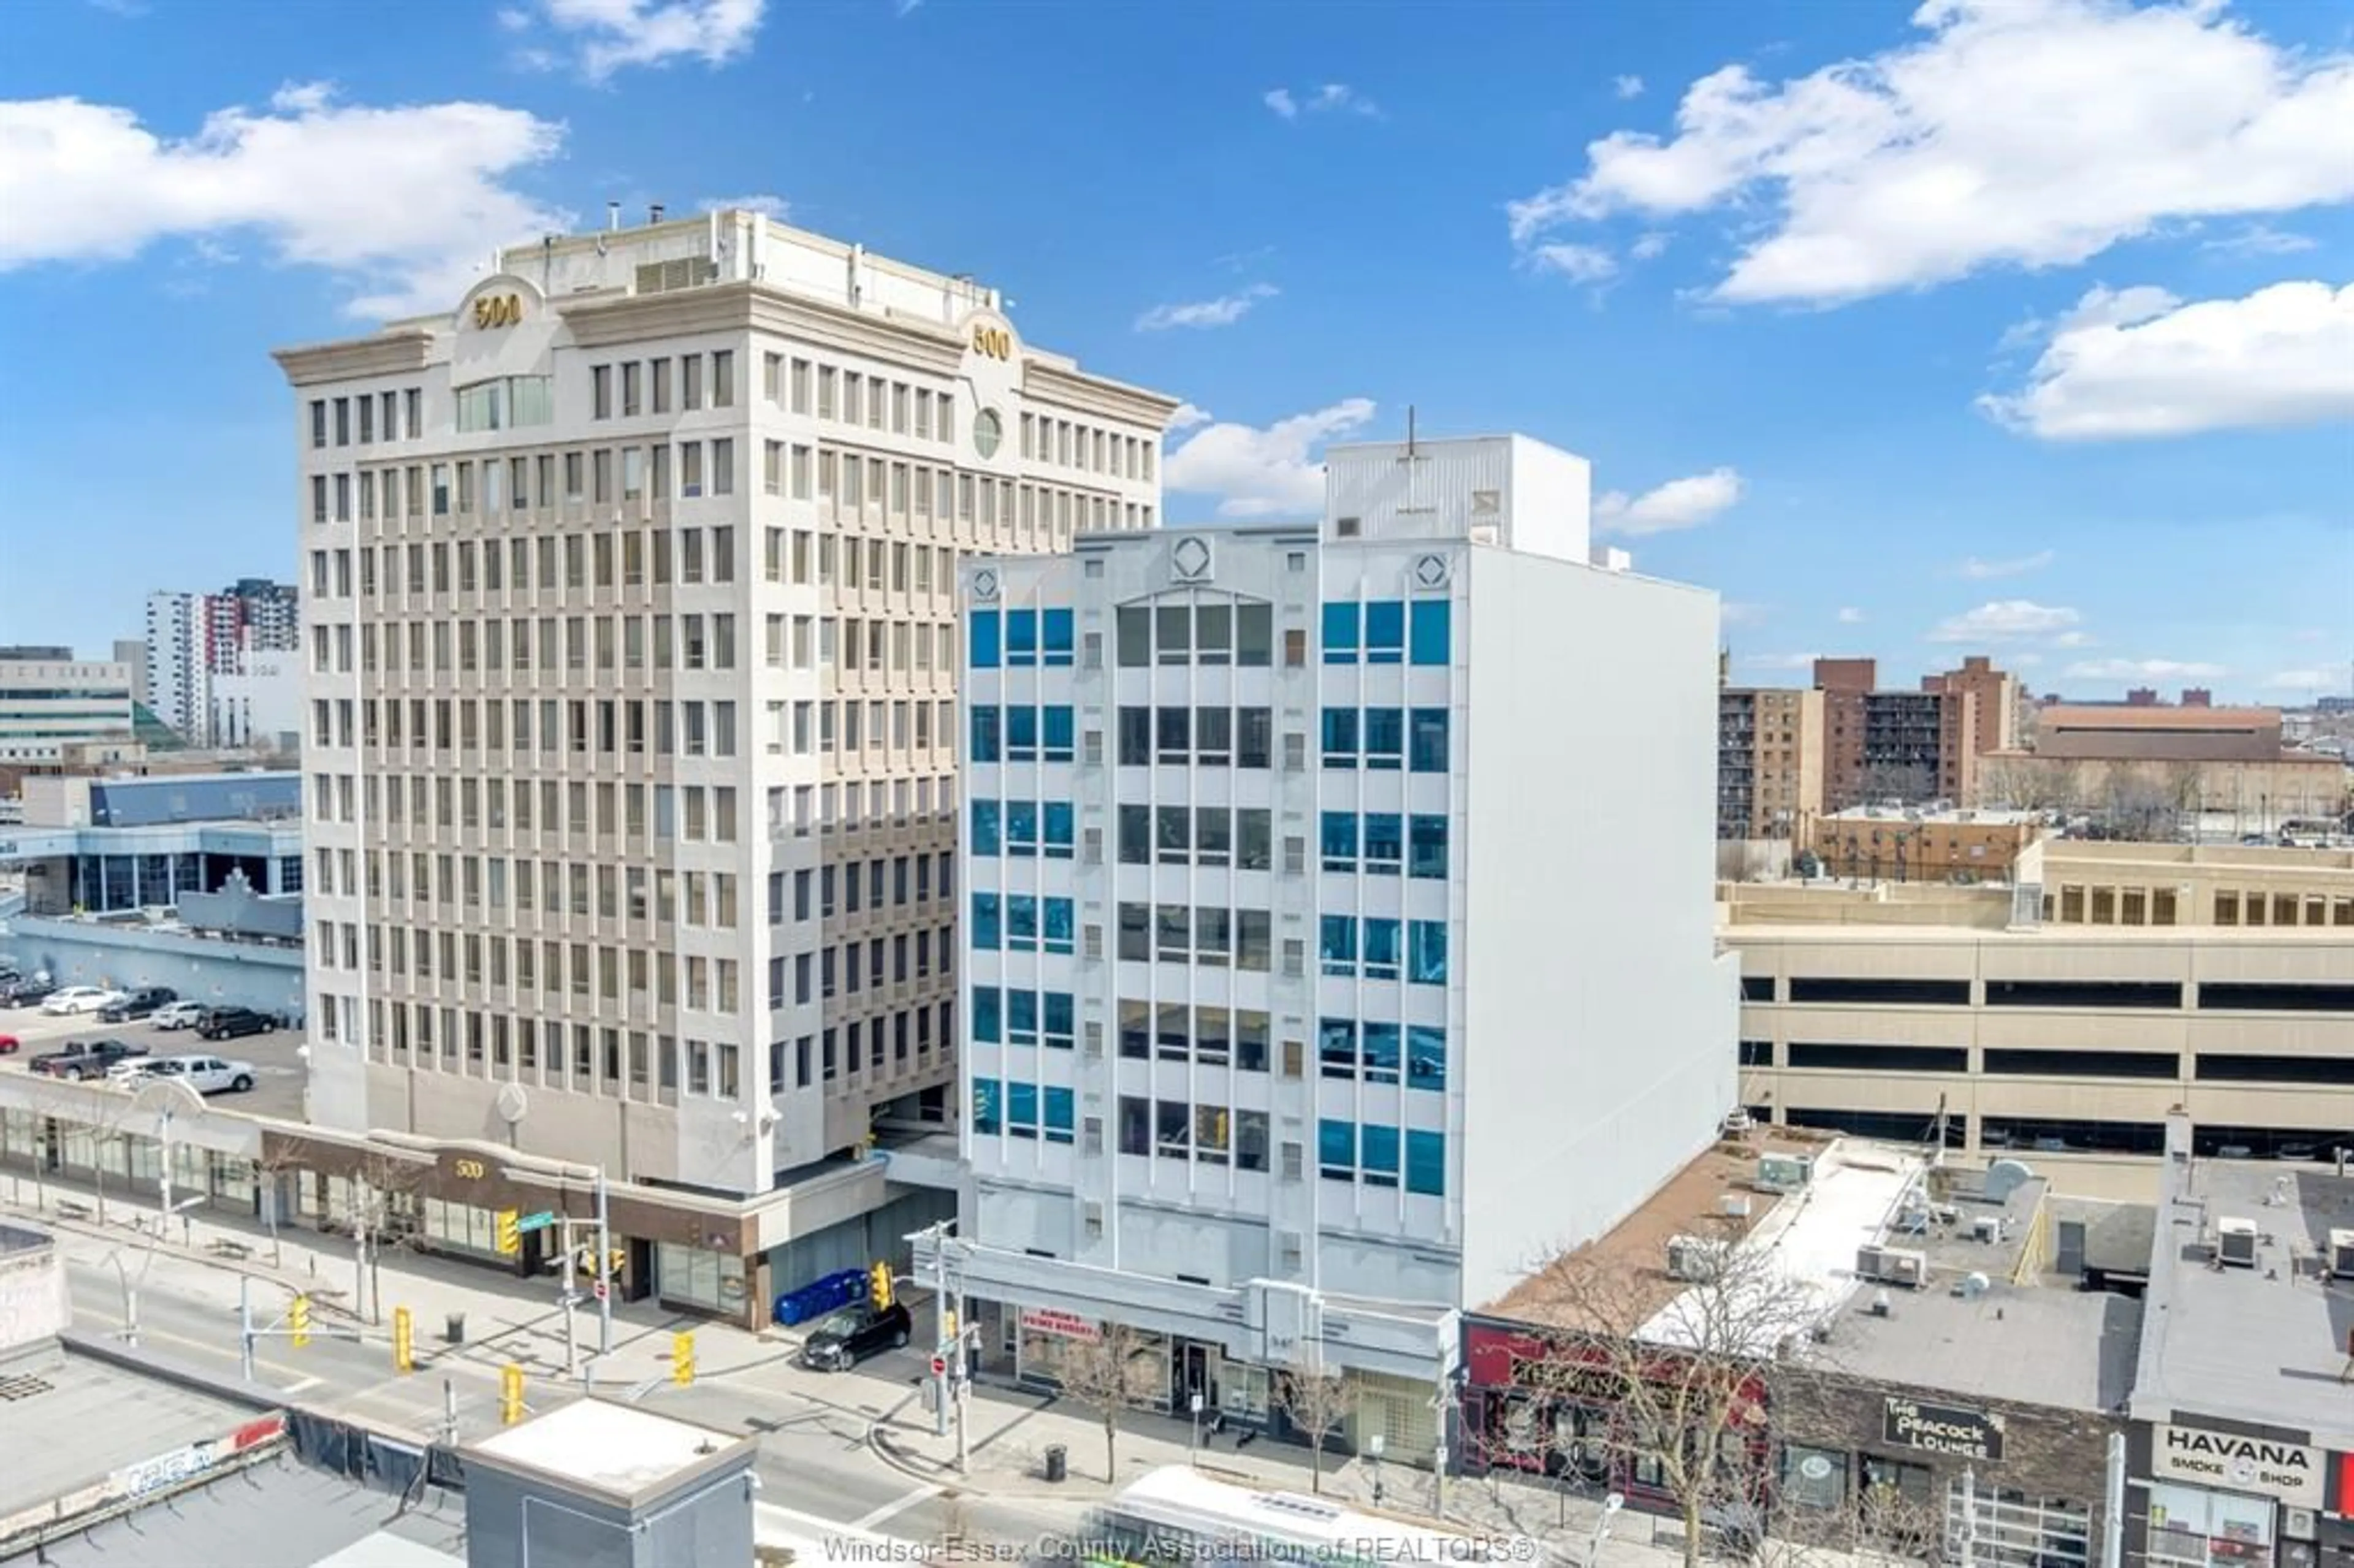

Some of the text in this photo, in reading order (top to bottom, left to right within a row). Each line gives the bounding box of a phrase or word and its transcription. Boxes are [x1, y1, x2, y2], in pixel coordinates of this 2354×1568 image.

[475, 294, 522, 330] 500
[973, 324, 1011, 362] 500
[455, 1158, 484, 1180] 500
[1896, 1415, 1985, 1441] PEACOCK
[1911, 1431, 1988, 1460] LOUNGE
[2167, 1429, 2309, 1469] HAVANA
[2171, 1456, 2303, 1486] SMOKE SHOP
